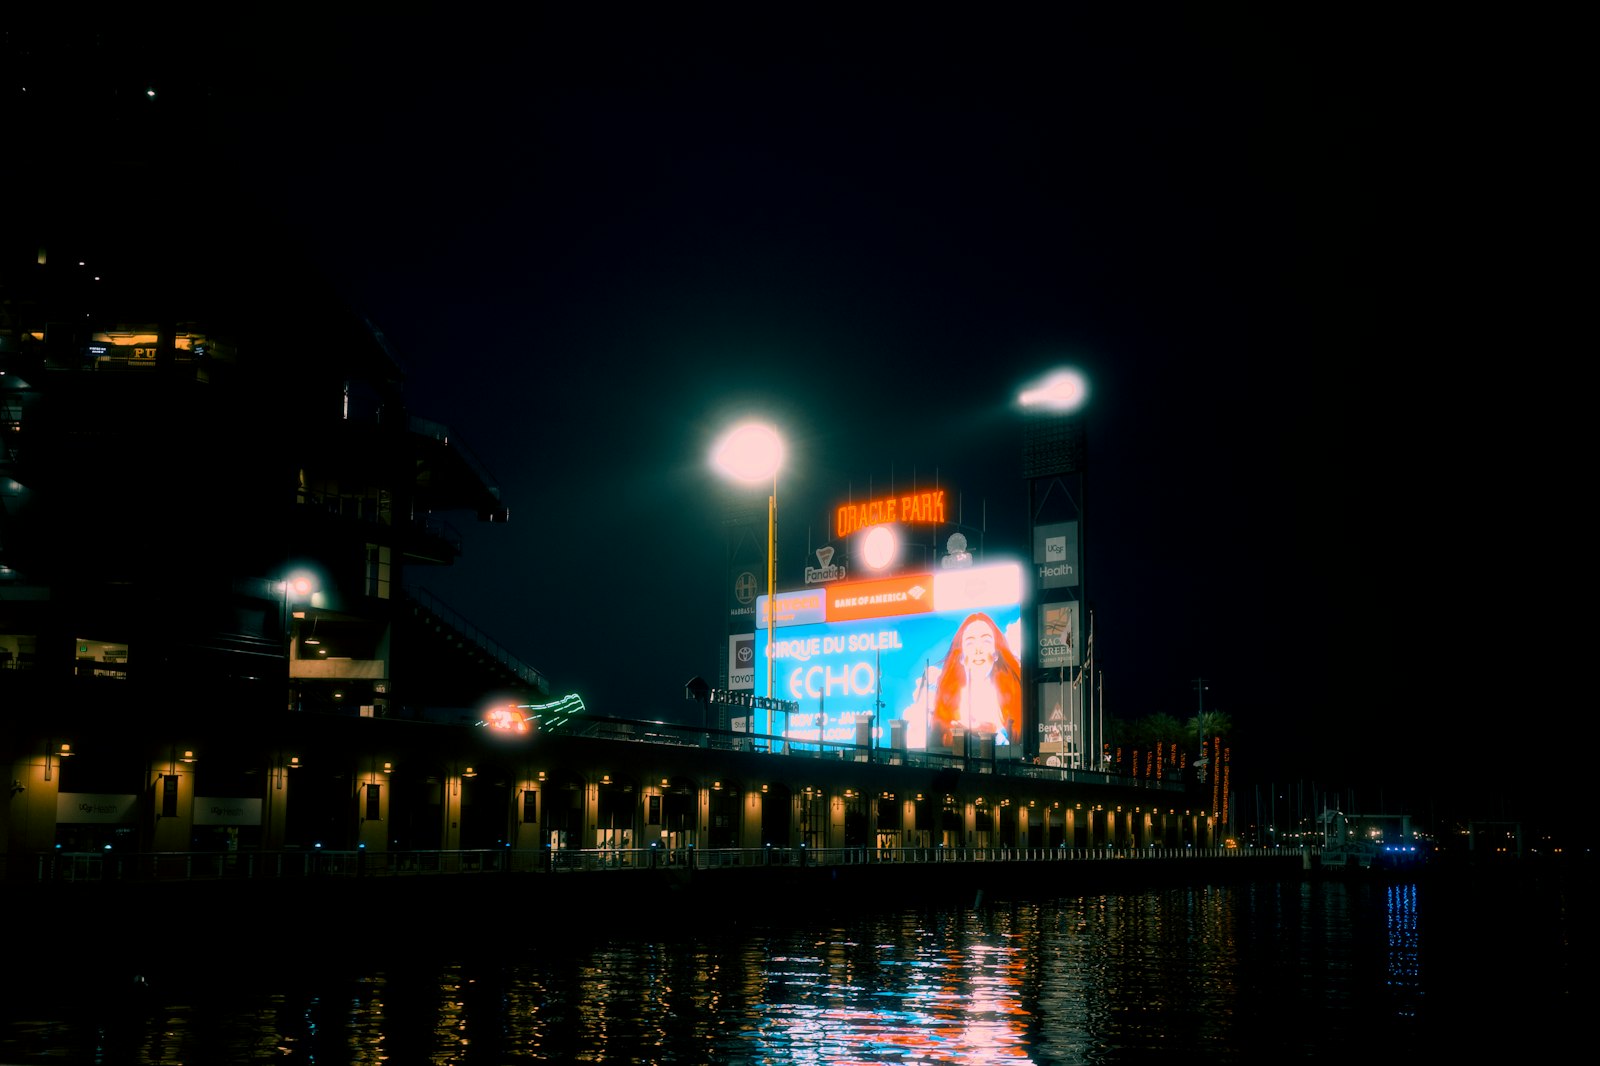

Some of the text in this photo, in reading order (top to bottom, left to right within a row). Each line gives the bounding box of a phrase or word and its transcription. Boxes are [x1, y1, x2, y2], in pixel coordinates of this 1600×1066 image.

[838, 490, 945, 537] ORACLE PARK
[806, 565, 844, 580] Fanatics
[1040, 564, 1072, 578] Health
[835, 592, 907, 608] BANK OF AMERICA
[765, 630, 903, 661] CIRQUE DU SOLEIL
[790, 662, 875, 699] ECHO
